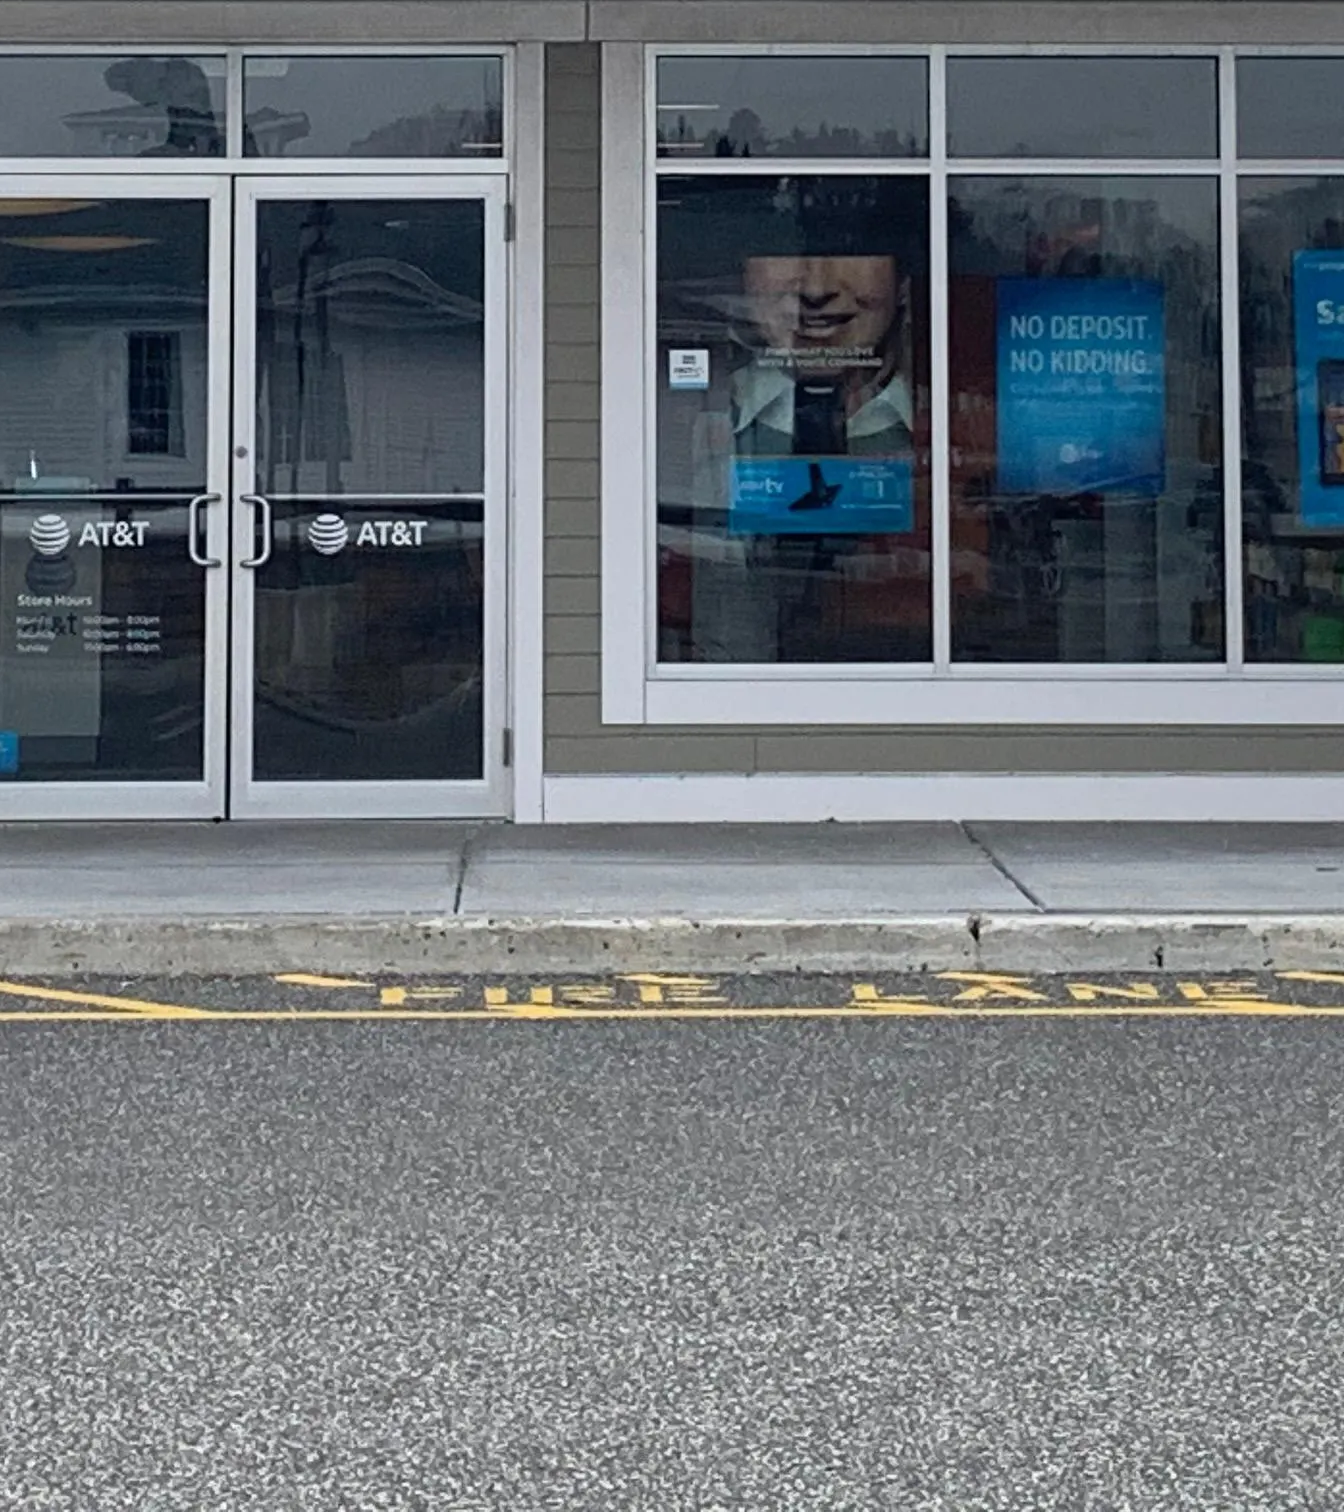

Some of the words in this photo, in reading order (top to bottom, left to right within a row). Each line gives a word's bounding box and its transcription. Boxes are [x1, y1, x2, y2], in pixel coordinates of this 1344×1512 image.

[1010, 315, 1044, 339] NO
[1050, 315, 1153, 339] DEPOSIT.
[1010, 349, 1044, 373] NO
[1050, 349, 1153, 374] KIDDING.
[78, 521, 150, 547] AT&T
[356, 520, 428, 546] AT&T
